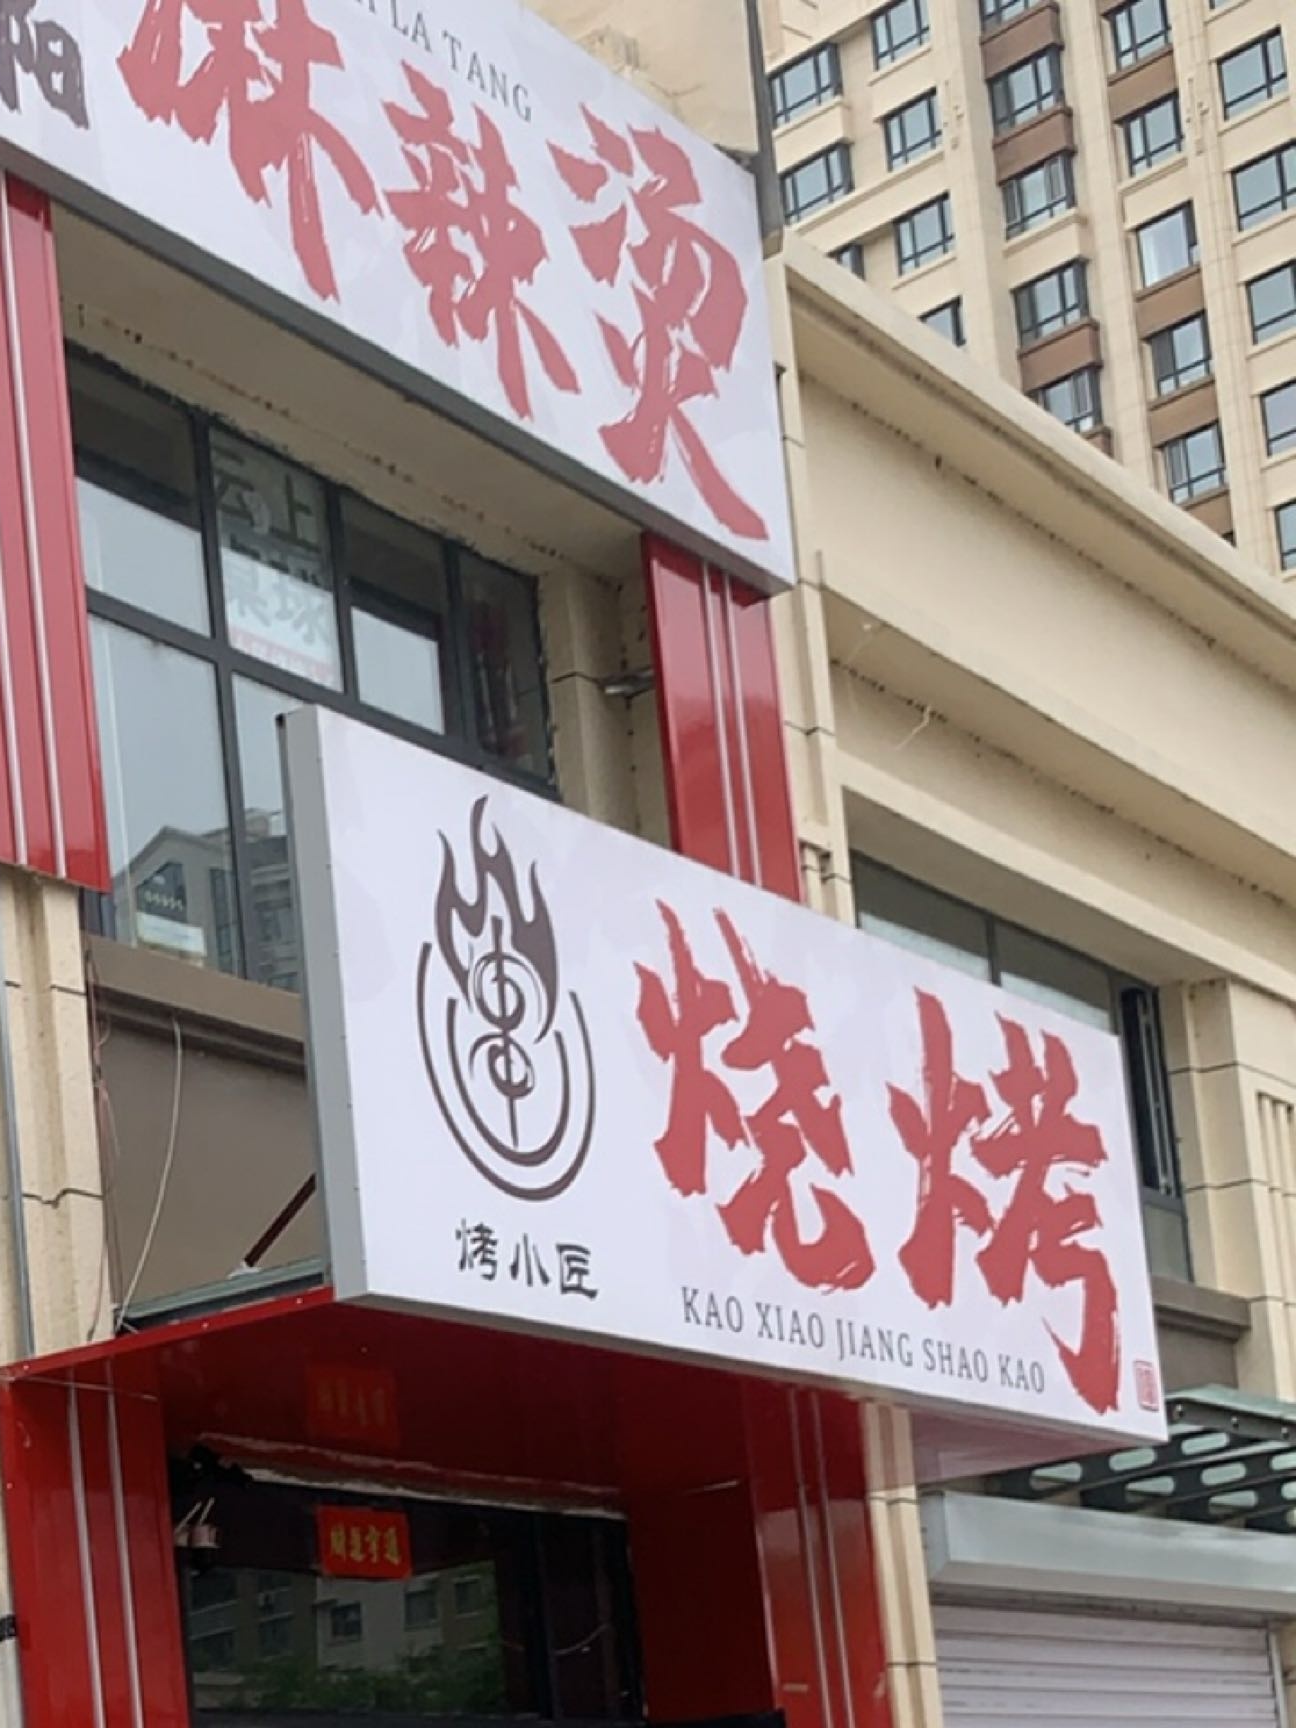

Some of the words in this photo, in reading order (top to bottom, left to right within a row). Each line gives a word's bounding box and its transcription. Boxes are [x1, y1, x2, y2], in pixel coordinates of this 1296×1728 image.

[389, 0, 433, 53] LA
[441, 30, 533, 123] TANG
[115, 0, 770, 541] 麻辣烫
[633, 898, 1123, 1417] 烧烤
[455, 1217, 599, 1300] 烤小匠
[681, 1286, 744, 1333] KAO
[755, 1302, 826, 1349] XIAO
[835, 1318, 913, 1367] JIANG
[921, 1338, 990, 1383] SHAO
[998, 1352, 1047, 1394] KAO
